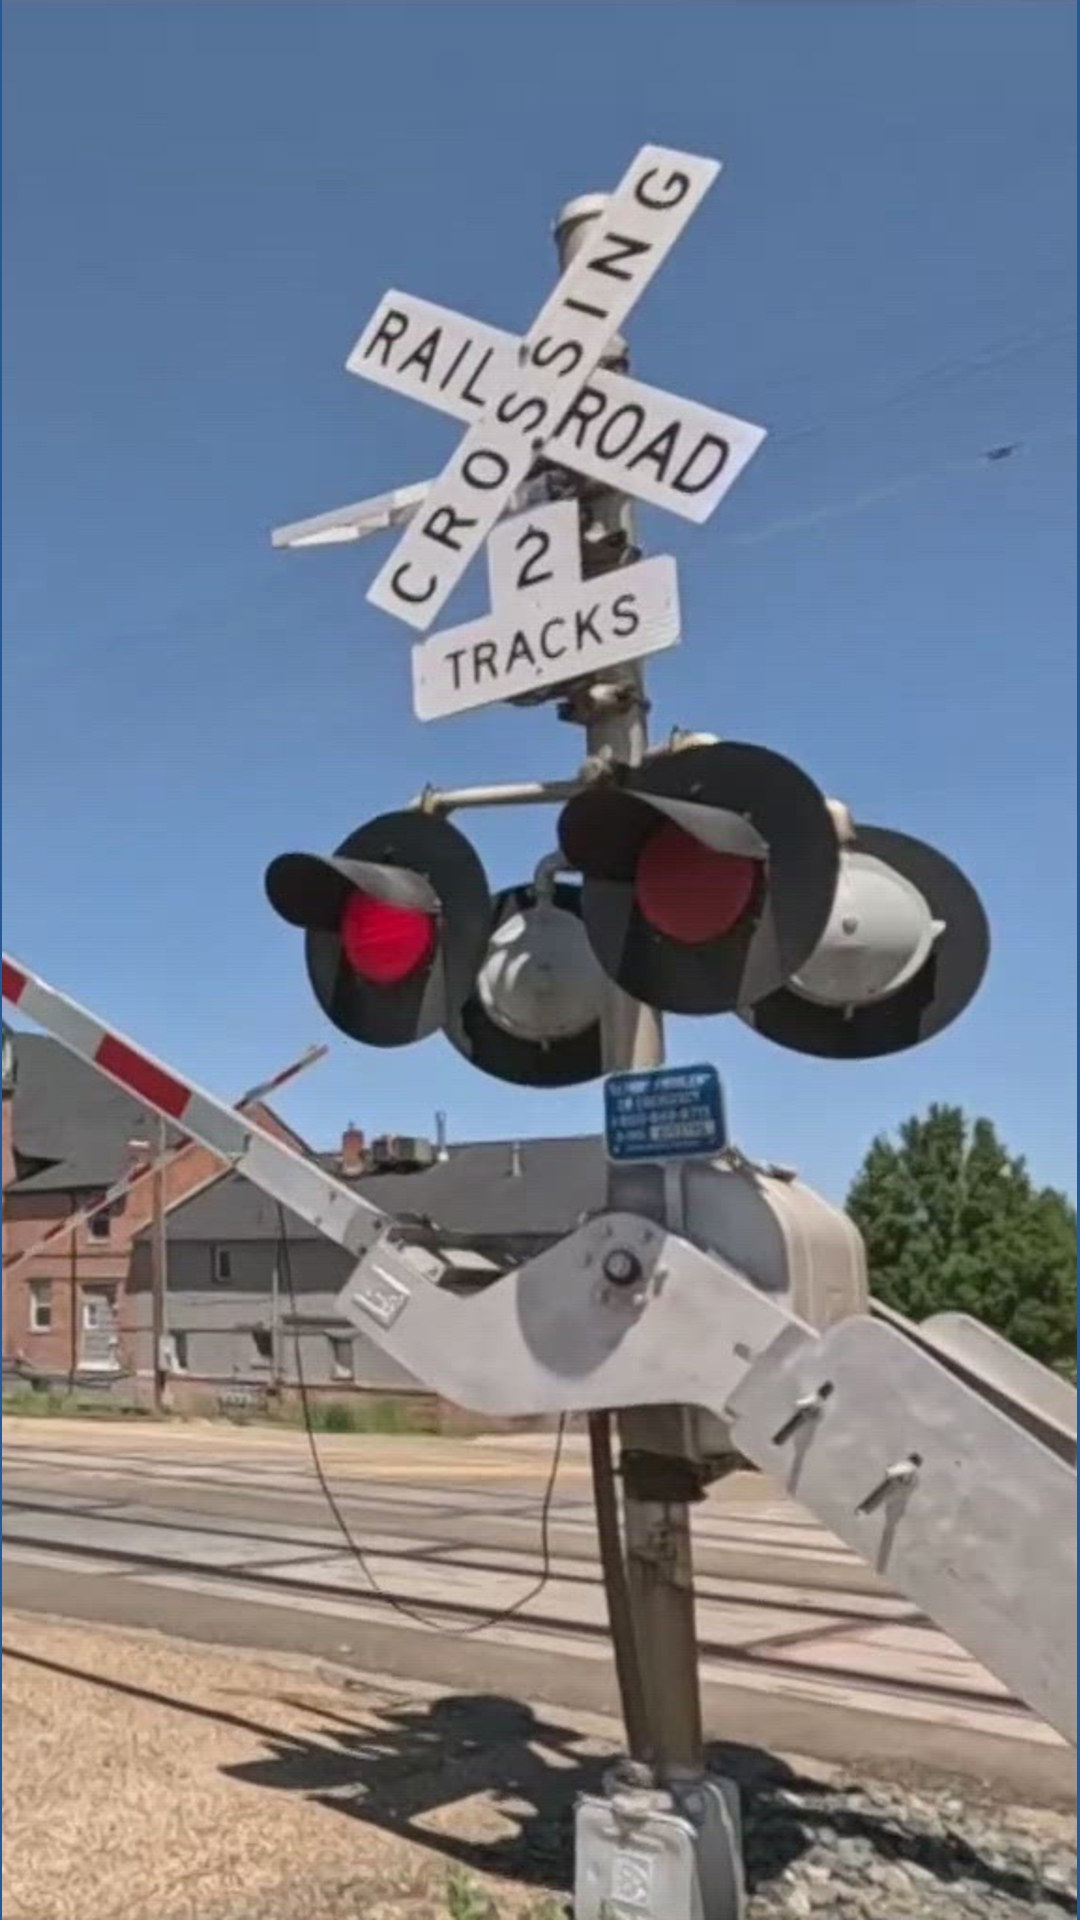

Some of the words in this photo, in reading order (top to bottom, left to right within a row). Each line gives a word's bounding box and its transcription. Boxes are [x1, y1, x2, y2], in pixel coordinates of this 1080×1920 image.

[363, 309, 494, 407] RAIL
[552, 386, 730, 495] ROAD
[391, 167, 690, 604] CROSSING
[514, 530, 554, 589] 2
[444, 594, 641, 690] TRACKS
